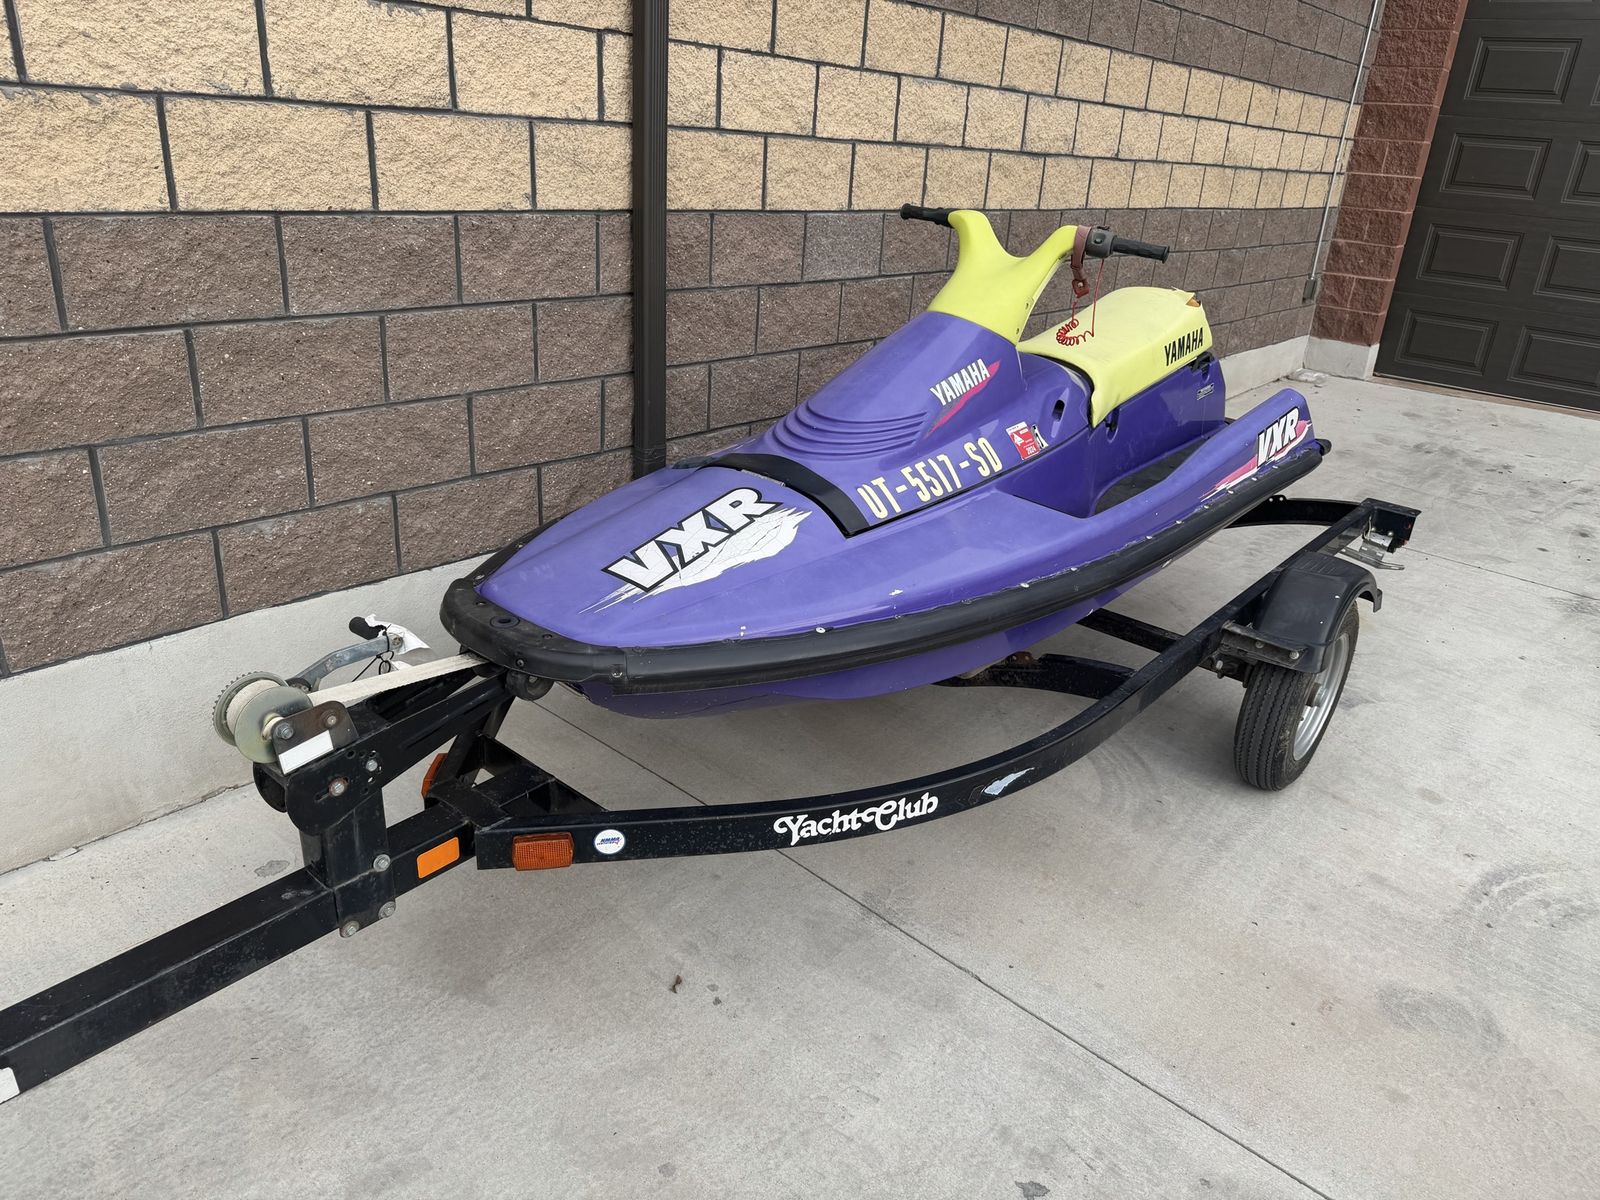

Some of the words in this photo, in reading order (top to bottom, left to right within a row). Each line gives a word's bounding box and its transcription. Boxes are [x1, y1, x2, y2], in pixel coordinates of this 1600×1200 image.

[1164, 327, 1204, 367] YAMAHA
[929, 358, 991, 406] YAMAHA
[1257, 406, 1300, 469] VXR
[601, 487, 784, 593] VXR
